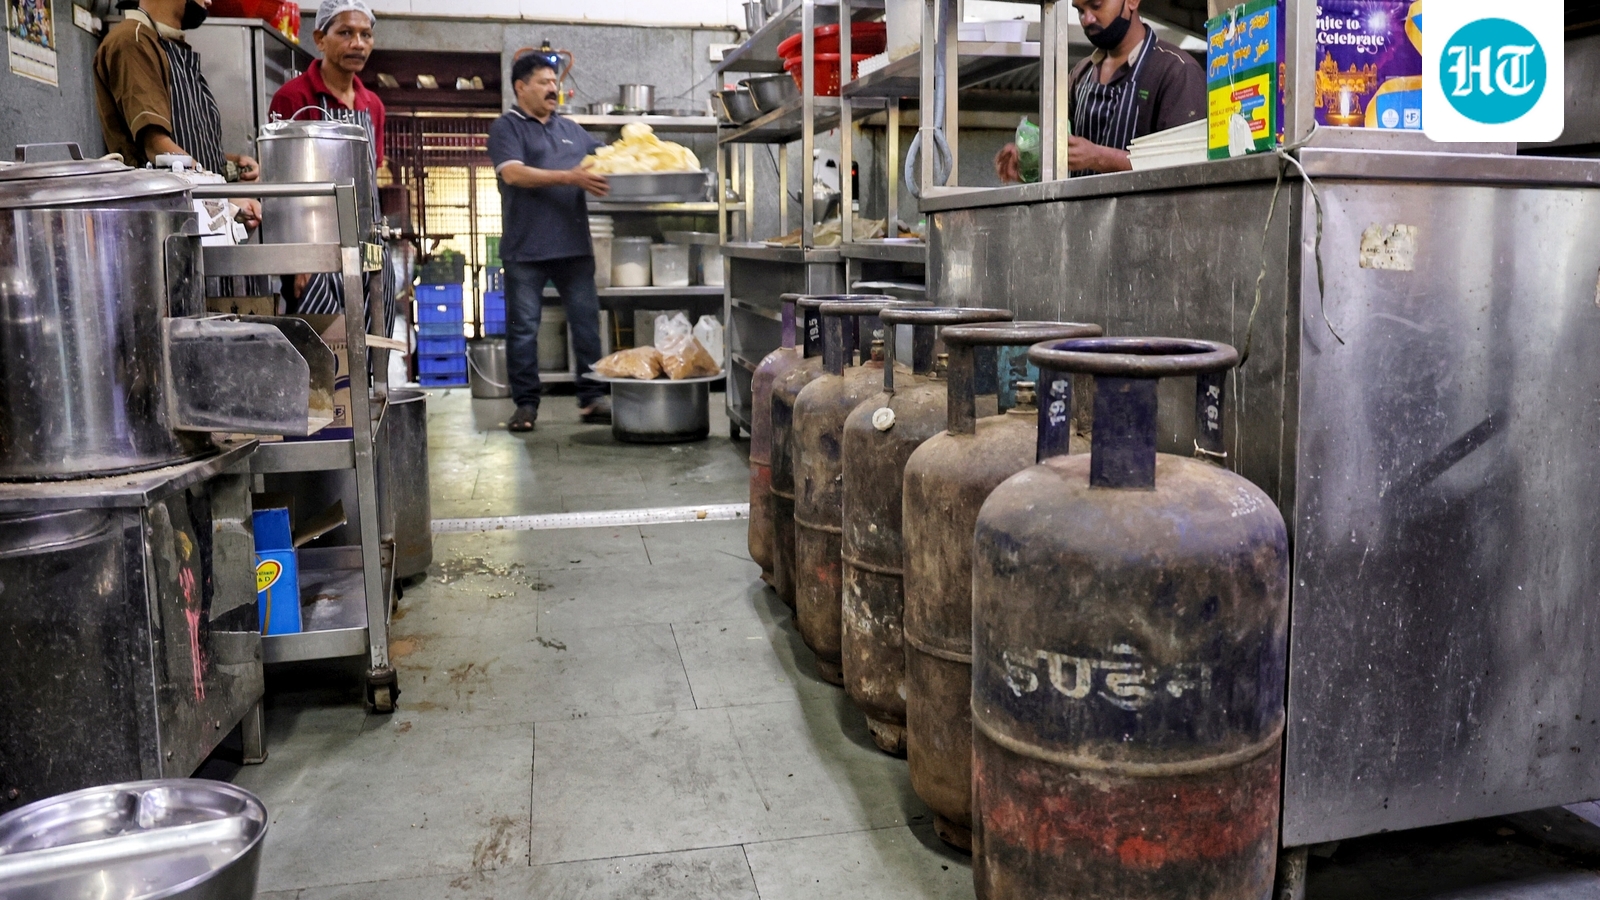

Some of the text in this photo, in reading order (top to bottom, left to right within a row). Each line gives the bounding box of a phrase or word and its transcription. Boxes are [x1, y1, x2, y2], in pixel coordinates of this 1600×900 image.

[1316, 16, 1361, 31] nite to
[1317, 31, 1385, 53] Celebrate
[808, 318, 819, 342] 19.5
[1049, 379, 1068, 427] 19.4
[1206, 384, 1220, 431] 19.4
